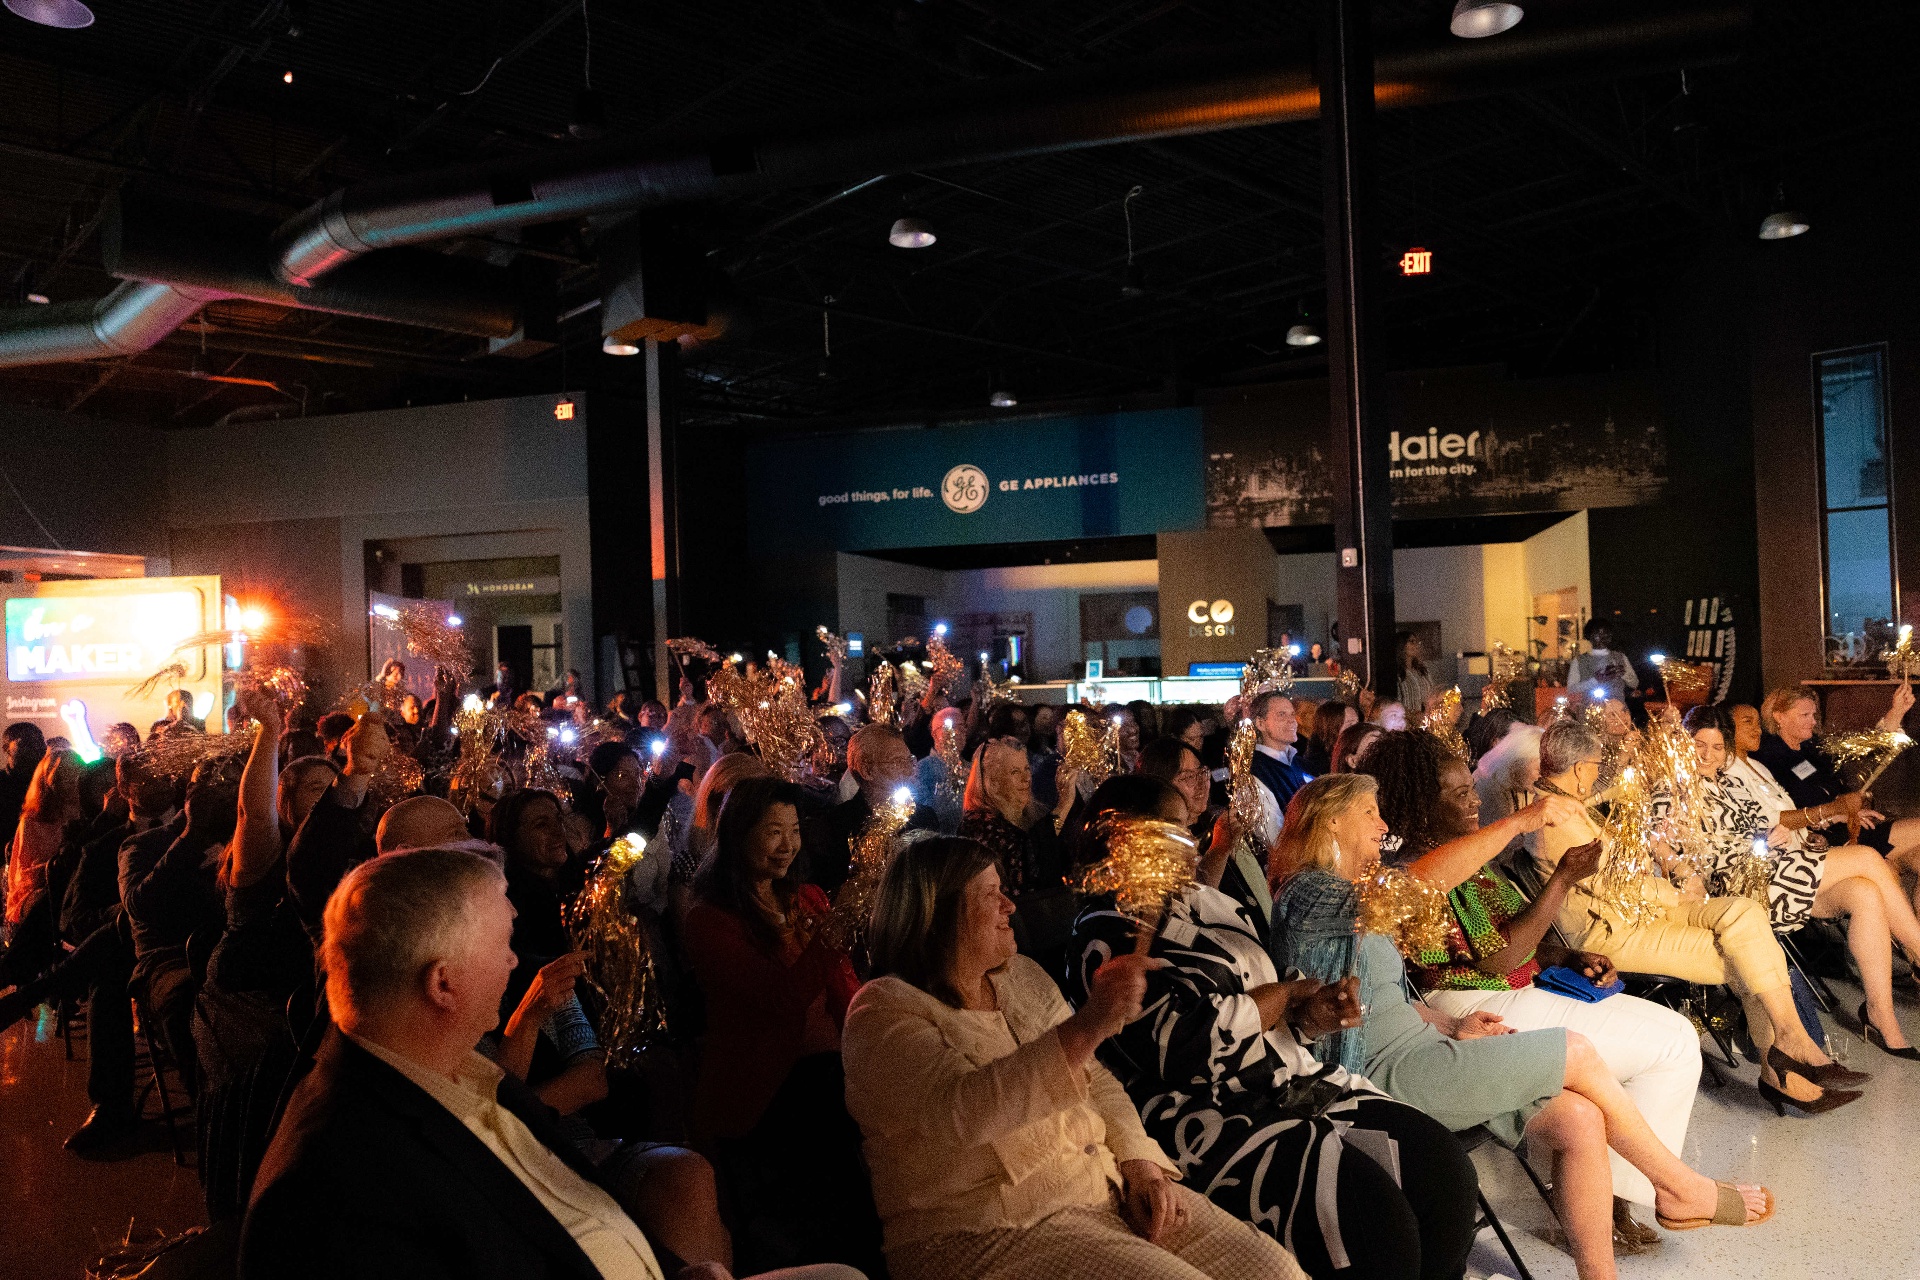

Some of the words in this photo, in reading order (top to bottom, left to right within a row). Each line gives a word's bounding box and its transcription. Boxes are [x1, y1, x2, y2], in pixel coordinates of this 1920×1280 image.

[1404, 251, 1432, 274] EXIT
[557, 403, 573, 420] EXIT
[1405, 466, 1425, 478] for
[1425, 464, 1448, 476] the
[1449, 463, 1477, 476] city.
[999, 480, 1019, 492] GE
[1023, 472, 1119, 490] APPLIANCES
[818, 492, 849, 506] good
[851, 490, 891, 503] things,
[892, 488, 910, 499] for
[912, 486, 934, 499] life.
[482, 583, 534, 592] MONOGRAM
[1188, 600, 1235, 624] CO
[16, 643, 143, 675] MAKER
[6, 696, 57, 712] Instagram
